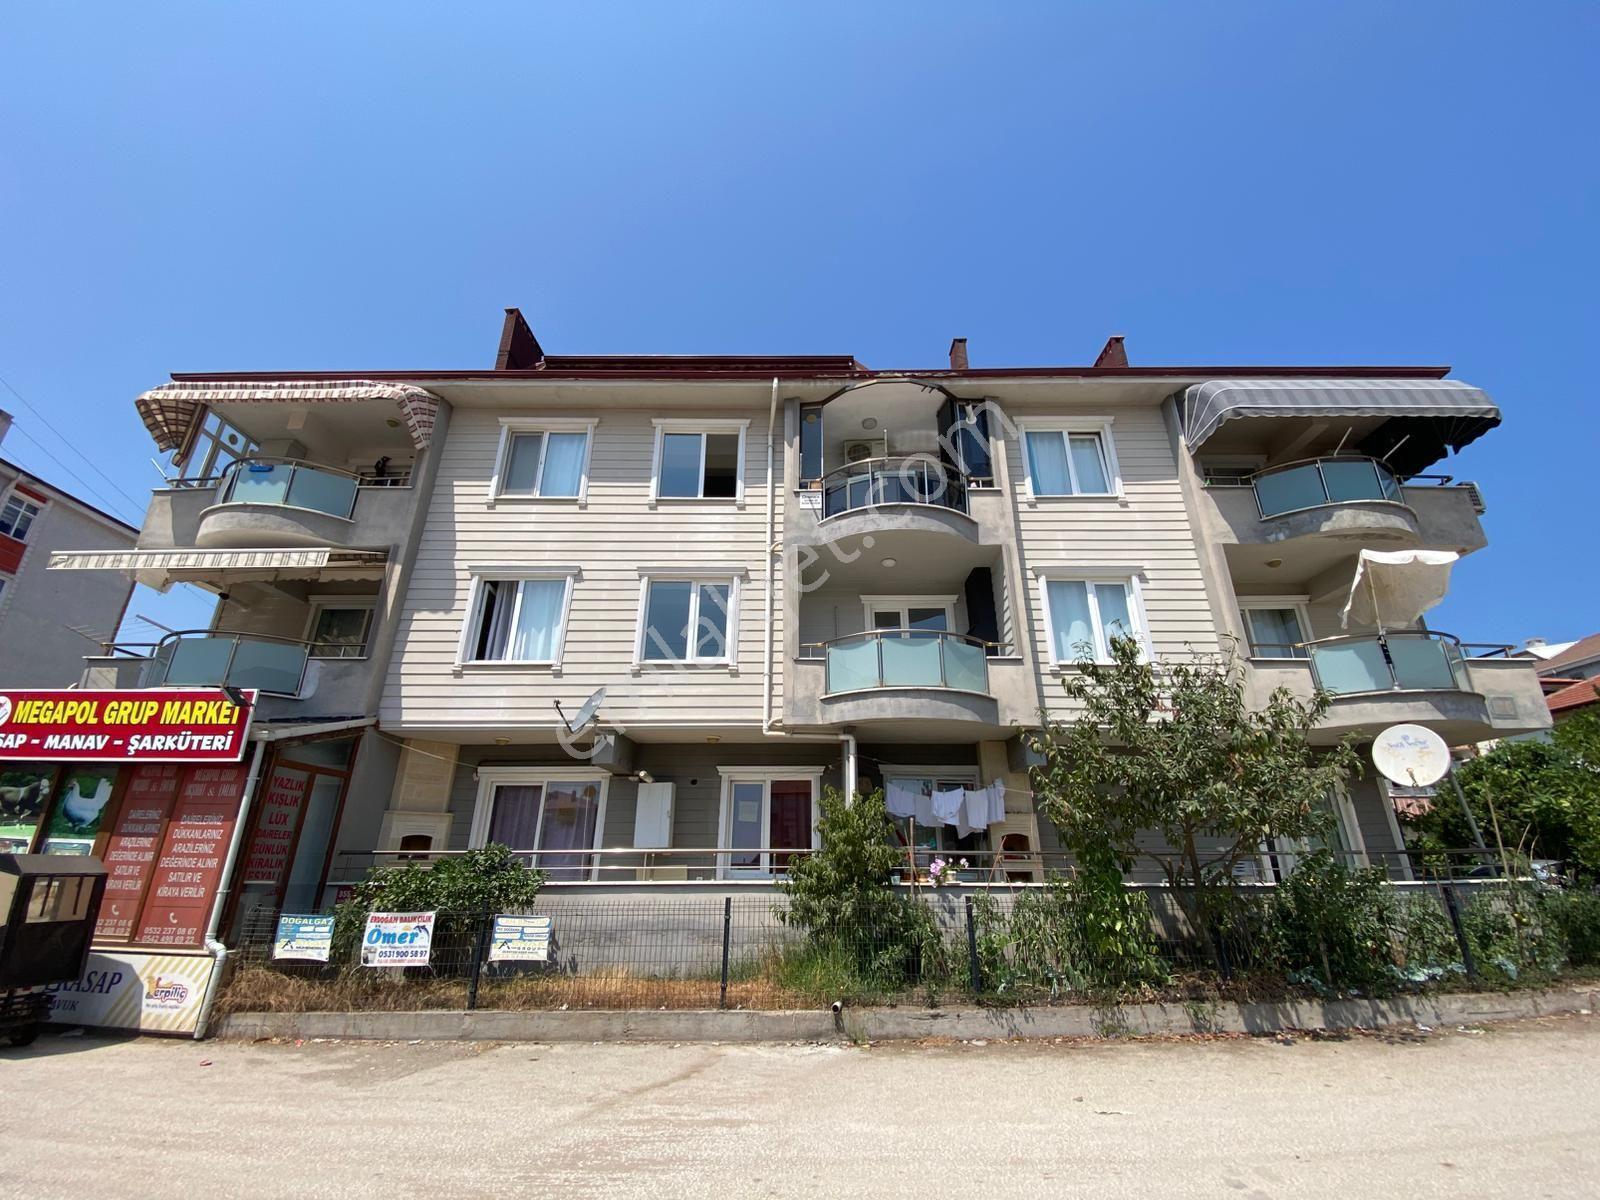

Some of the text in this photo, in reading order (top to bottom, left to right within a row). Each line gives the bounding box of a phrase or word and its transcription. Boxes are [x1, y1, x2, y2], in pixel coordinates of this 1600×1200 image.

[12, 700, 240, 725] MEGAPOL GRUP MARKET
[44, 734, 110, 750] MANAV
[127, 730, 235, 756] ŞARKÜTERİ
[273, 775, 305, 791] YAZLIK
[267, 791, 300, 808] KIŞLIK
[192, 873, 202, 883] VE
[162, 927, 177, 935] 237
[367, 925, 419, 944] Ömer
